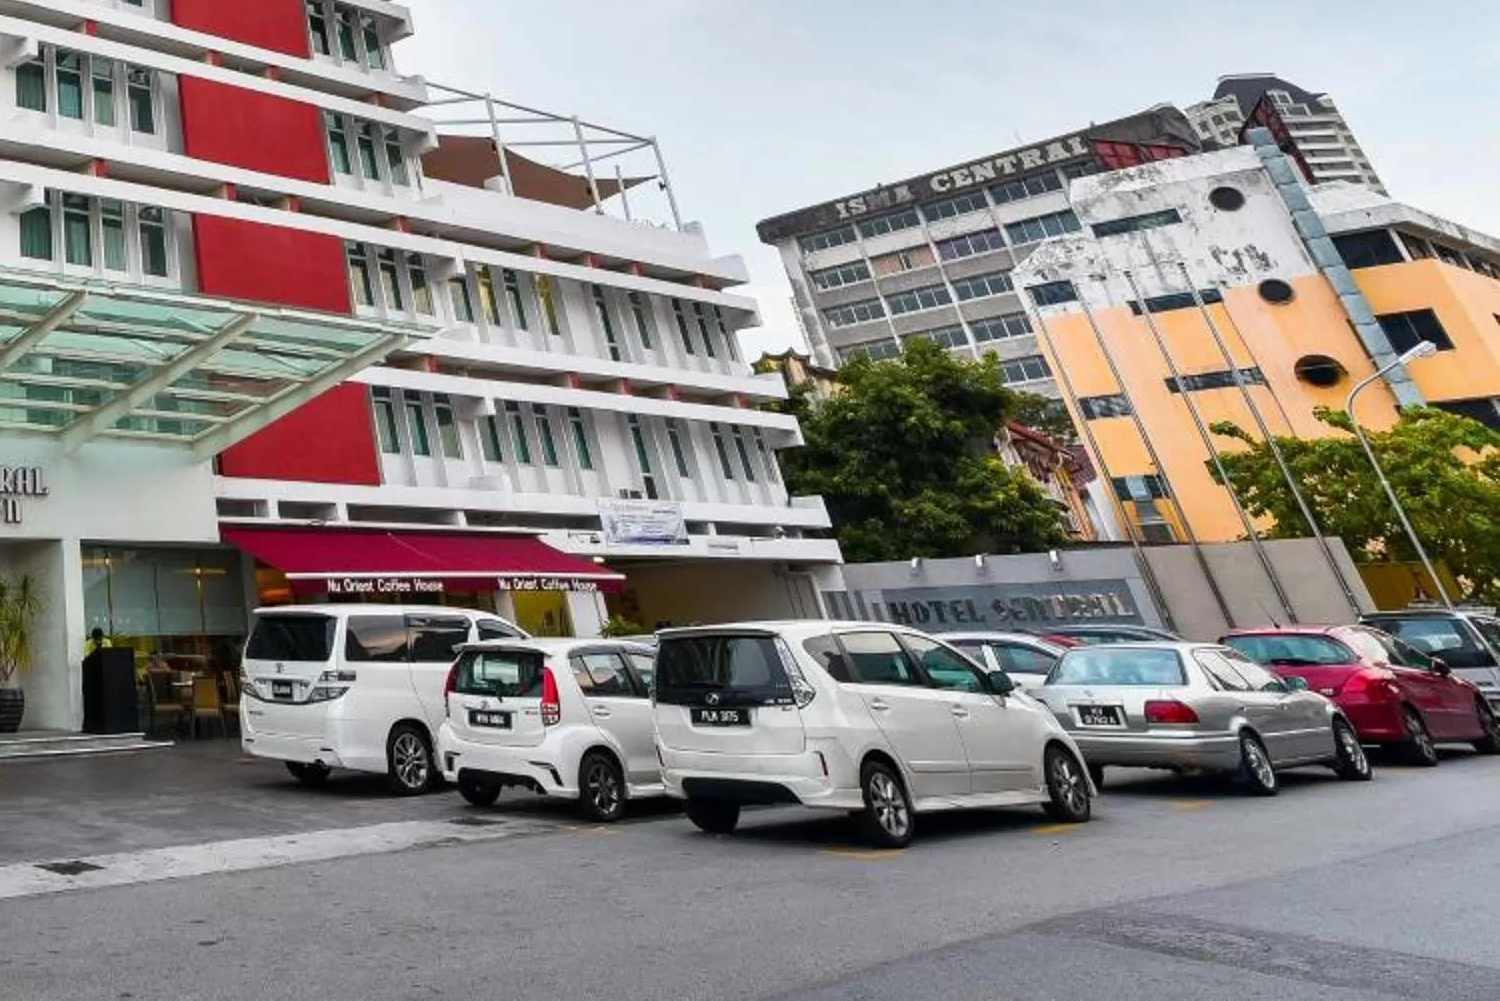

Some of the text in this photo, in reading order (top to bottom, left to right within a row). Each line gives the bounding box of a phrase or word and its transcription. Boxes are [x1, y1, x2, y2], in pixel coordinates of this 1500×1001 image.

[930, 137, 1089, 193] CENTRAL
[377, 578, 411, 592] Coffee
[414, 578, 445, 592] House
[886, 599, 986, 625] HOTEL
